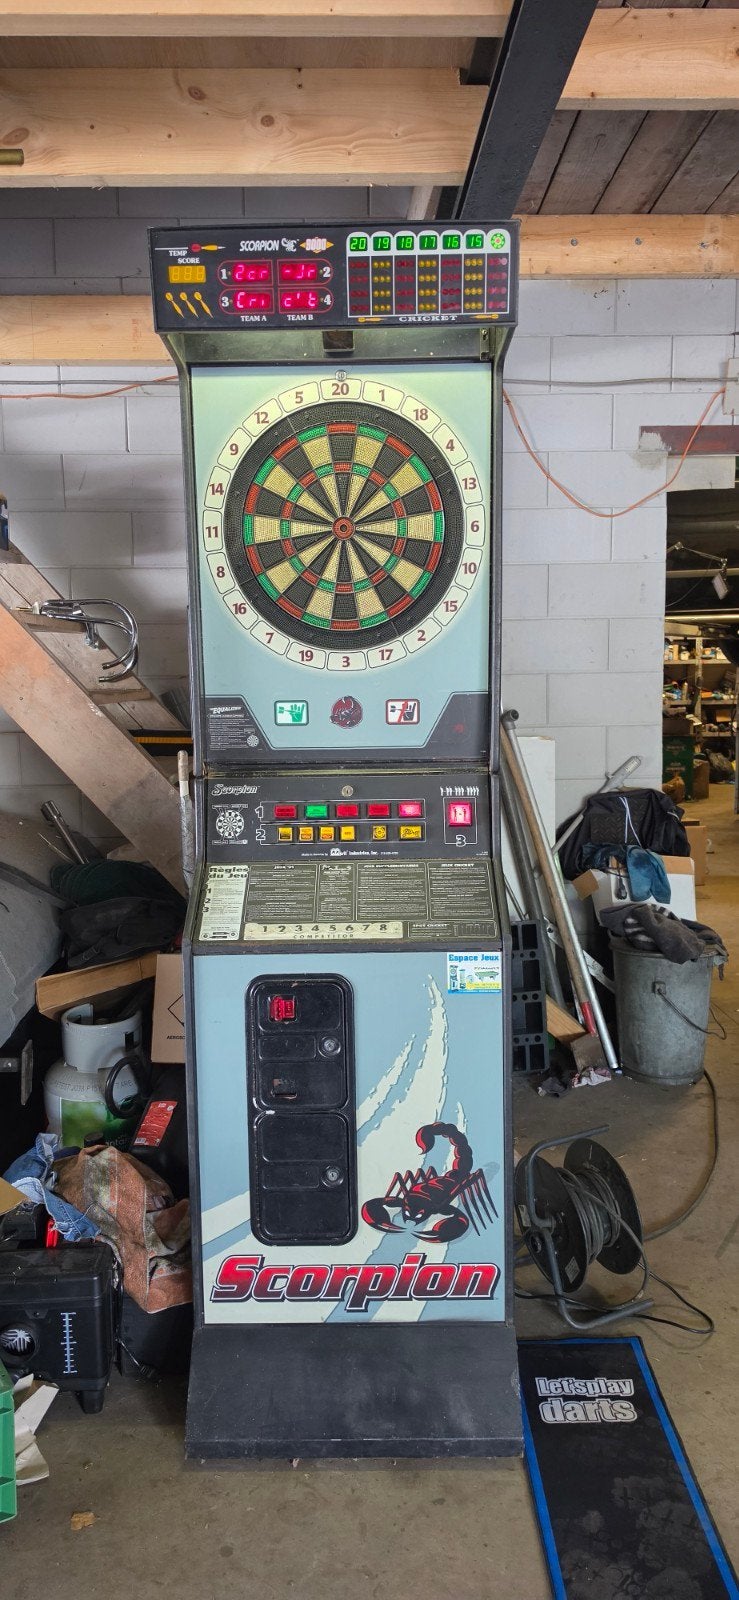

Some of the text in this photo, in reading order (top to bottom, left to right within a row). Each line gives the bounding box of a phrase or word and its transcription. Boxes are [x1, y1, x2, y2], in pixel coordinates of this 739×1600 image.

[239, 239, 279, 252] SCORPION
[350, 237, 367, 250] 20
[377, 236, 390, 249] 19
[400, 236, 413, 249] 18
[424, 235, 436, 248] 17
[446, 235, 459, 247] 16
[470, 235, 482, 247] 15
[220, 269, 229, 280] 1
[323, 266, 331, 277] 2
[221, 297, 230, 307] 3
[323, 294, 332, 305] 4
[331, 383, 350, 396] 20
[379, 389, 385, 402] 1
[295, 391, 304, 404] 5
[254, 411, 270, 424] 12
[413, 408, 429, 421] 18
[229, 443, 239, 456] 9
[446, 439, 455, 452] 4
[209, 483, 224, 496] 14
[461, 477, 477, 490] 13
[205, 526, 219, 538] 11
[470, 520, 480, 533] 6
[216, 566, 226, 578] 8
[462, 562, 477, 574] 10
[232, 603, 247, 615] 16
[443, 600, 458, 612] 15
[265, 632, 274, 644] 7
[417, 630, 426, 641] 2
[298, 650, 314, 662] 19
[379, 648, 394, 661] 17
[342, 656, 350, 668] 3
[211, 784, 258, 797] Scorpion
[254, 805, 264, 819] 1
[255, 829, 266, 841] 2
[455, 834, 467, 848] 3
[209, 866, 249, 874] Règles
[262, 925, 268, 933] 1
[278, 925, 287, 933] 2
[311, 924, 320, 932] 4
[329, 924, 337, 932] 5
[448, 953, 500, 963] Espace Jeux
[211, 1253, 500, 1312] Scorpion
[539, 1397, 638, 1424] darts
